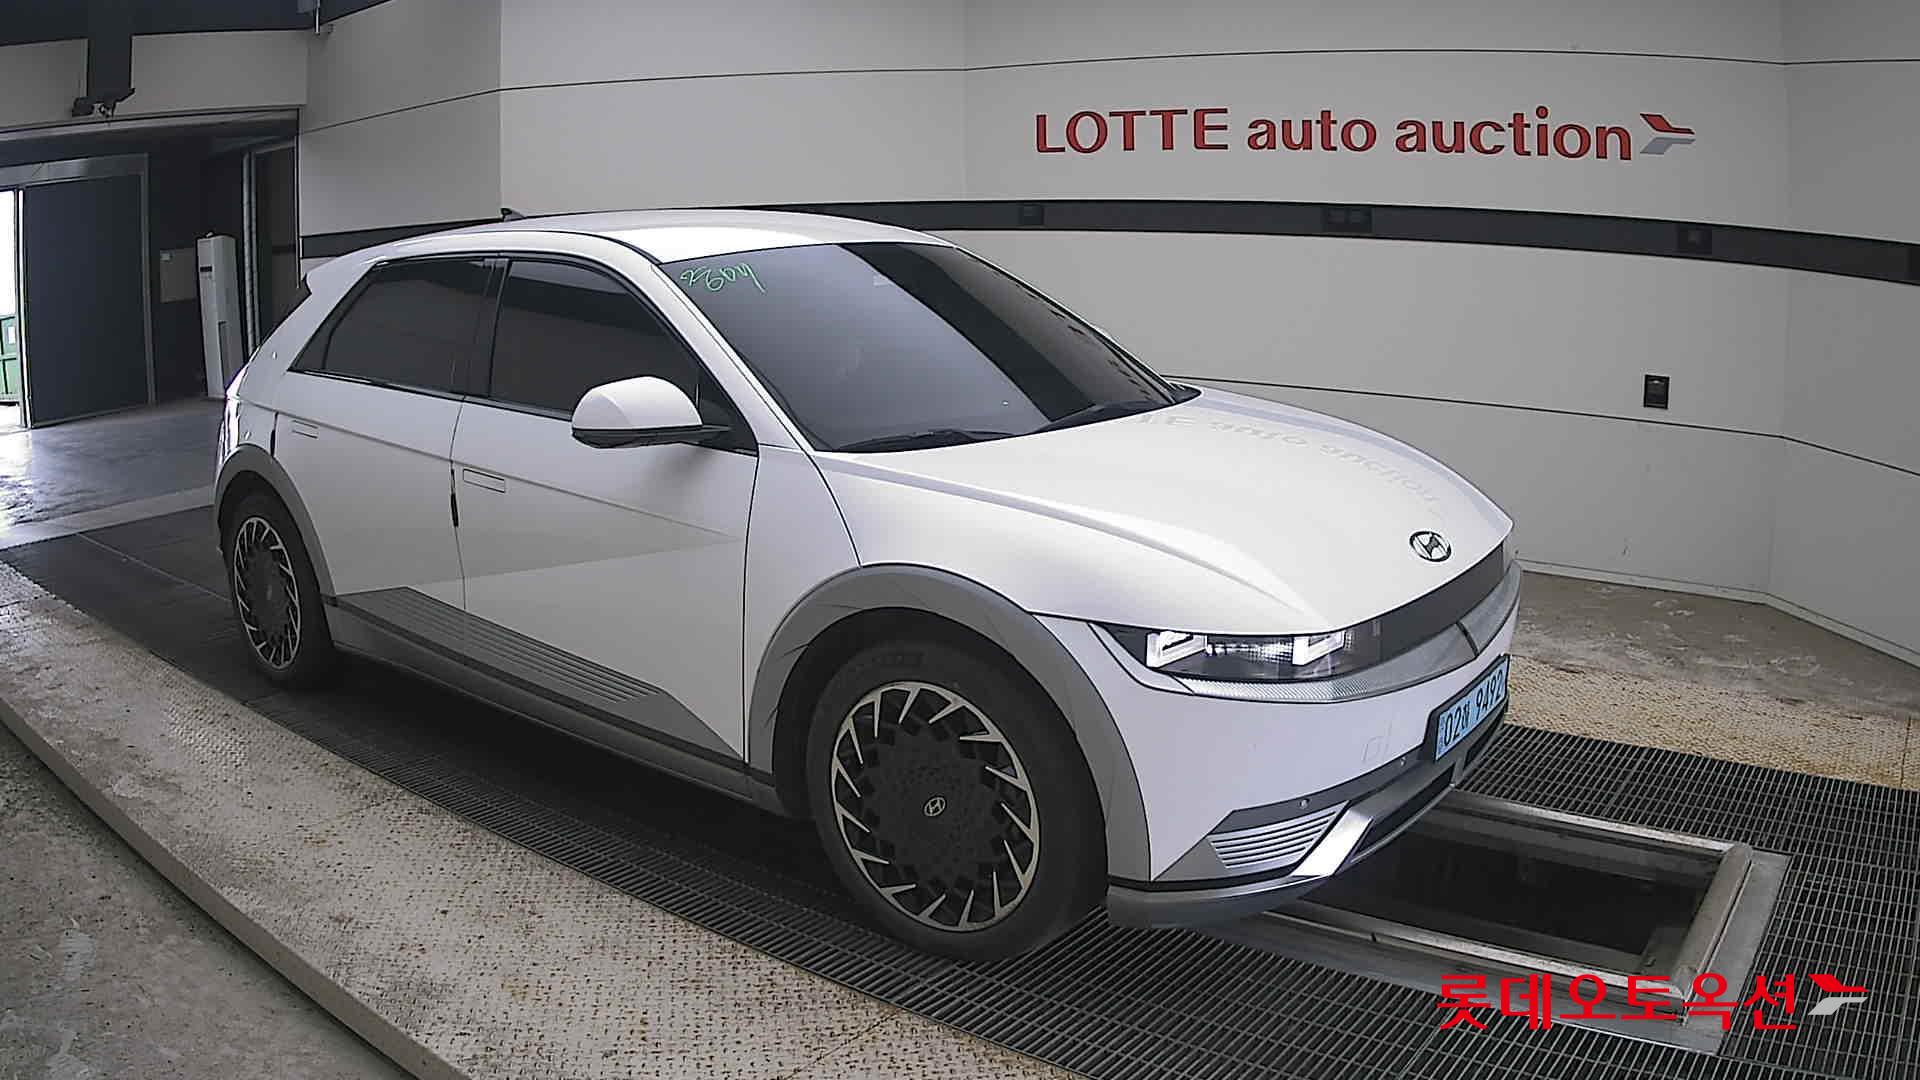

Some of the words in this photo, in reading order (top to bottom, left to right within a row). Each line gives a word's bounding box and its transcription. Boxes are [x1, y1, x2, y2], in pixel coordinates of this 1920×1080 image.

[1036, 108, 1229, 154] LOTTE
[1246, 109, 1377, 152] auto
[1395, 105, 1633, 161] auction
[1476, 669, 1503, 720] 9492
